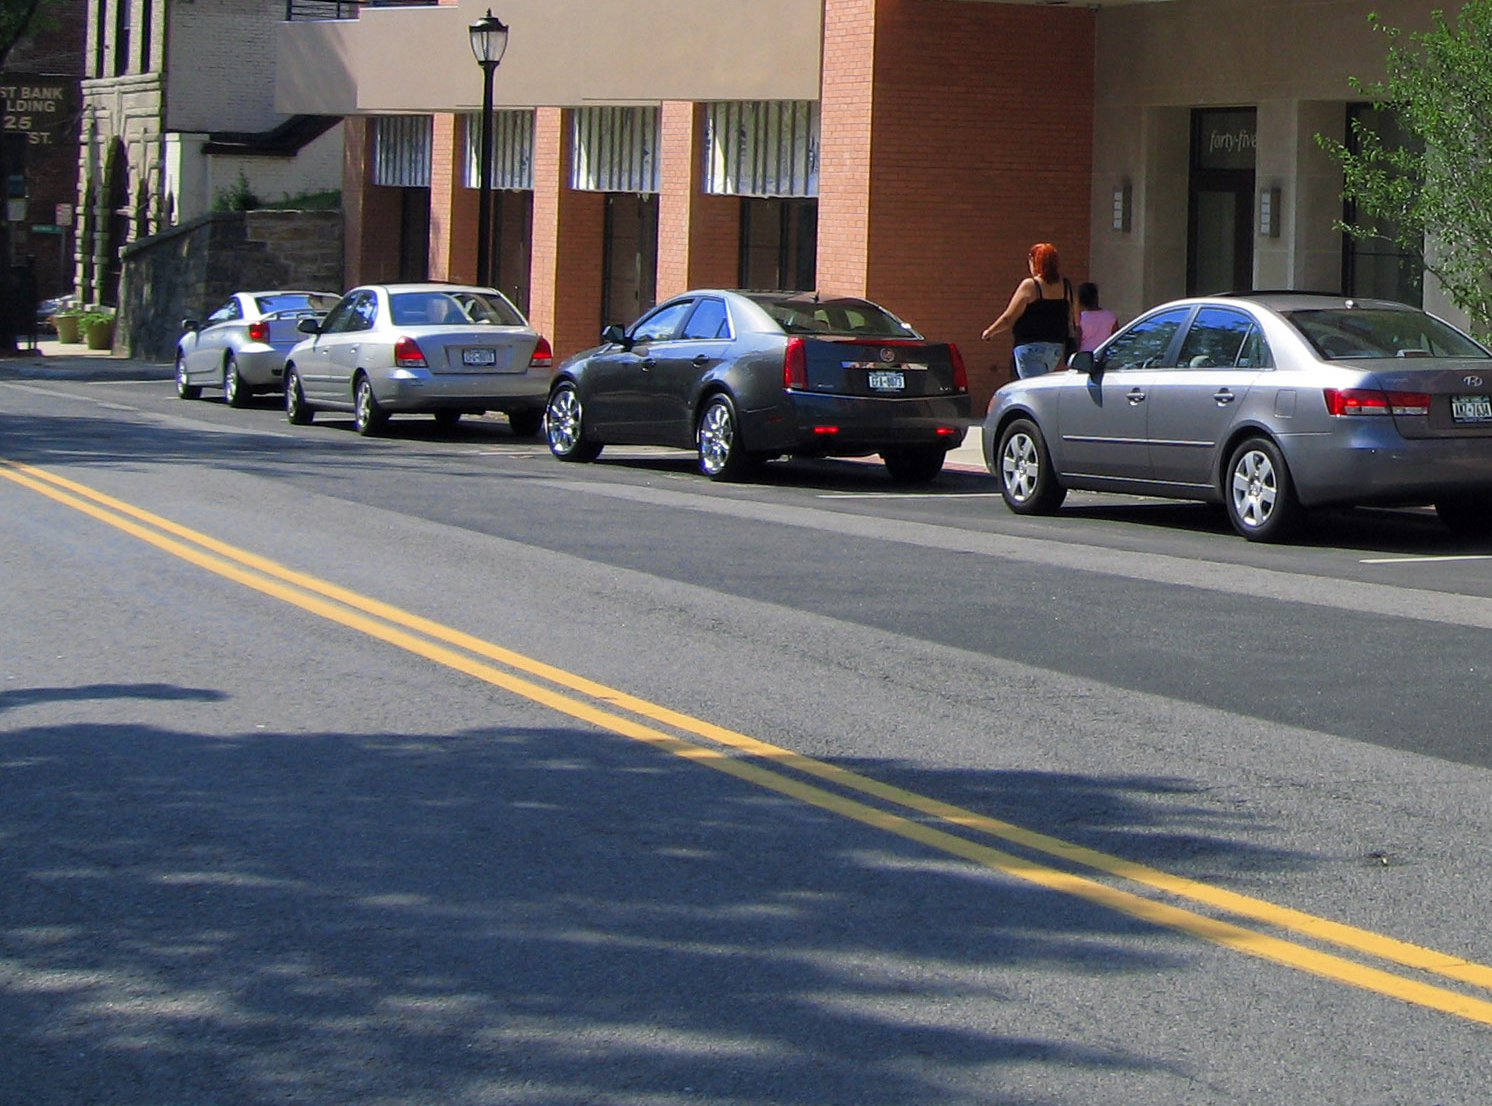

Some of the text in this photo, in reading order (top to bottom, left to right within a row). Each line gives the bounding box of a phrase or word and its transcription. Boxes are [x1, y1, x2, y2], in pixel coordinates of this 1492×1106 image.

[21, 86, 64, 100] BANK
[6, 100, 56, 113] LDING
[4, 115, 32, 130] 25
[28, 132, 52, 144] ST.
